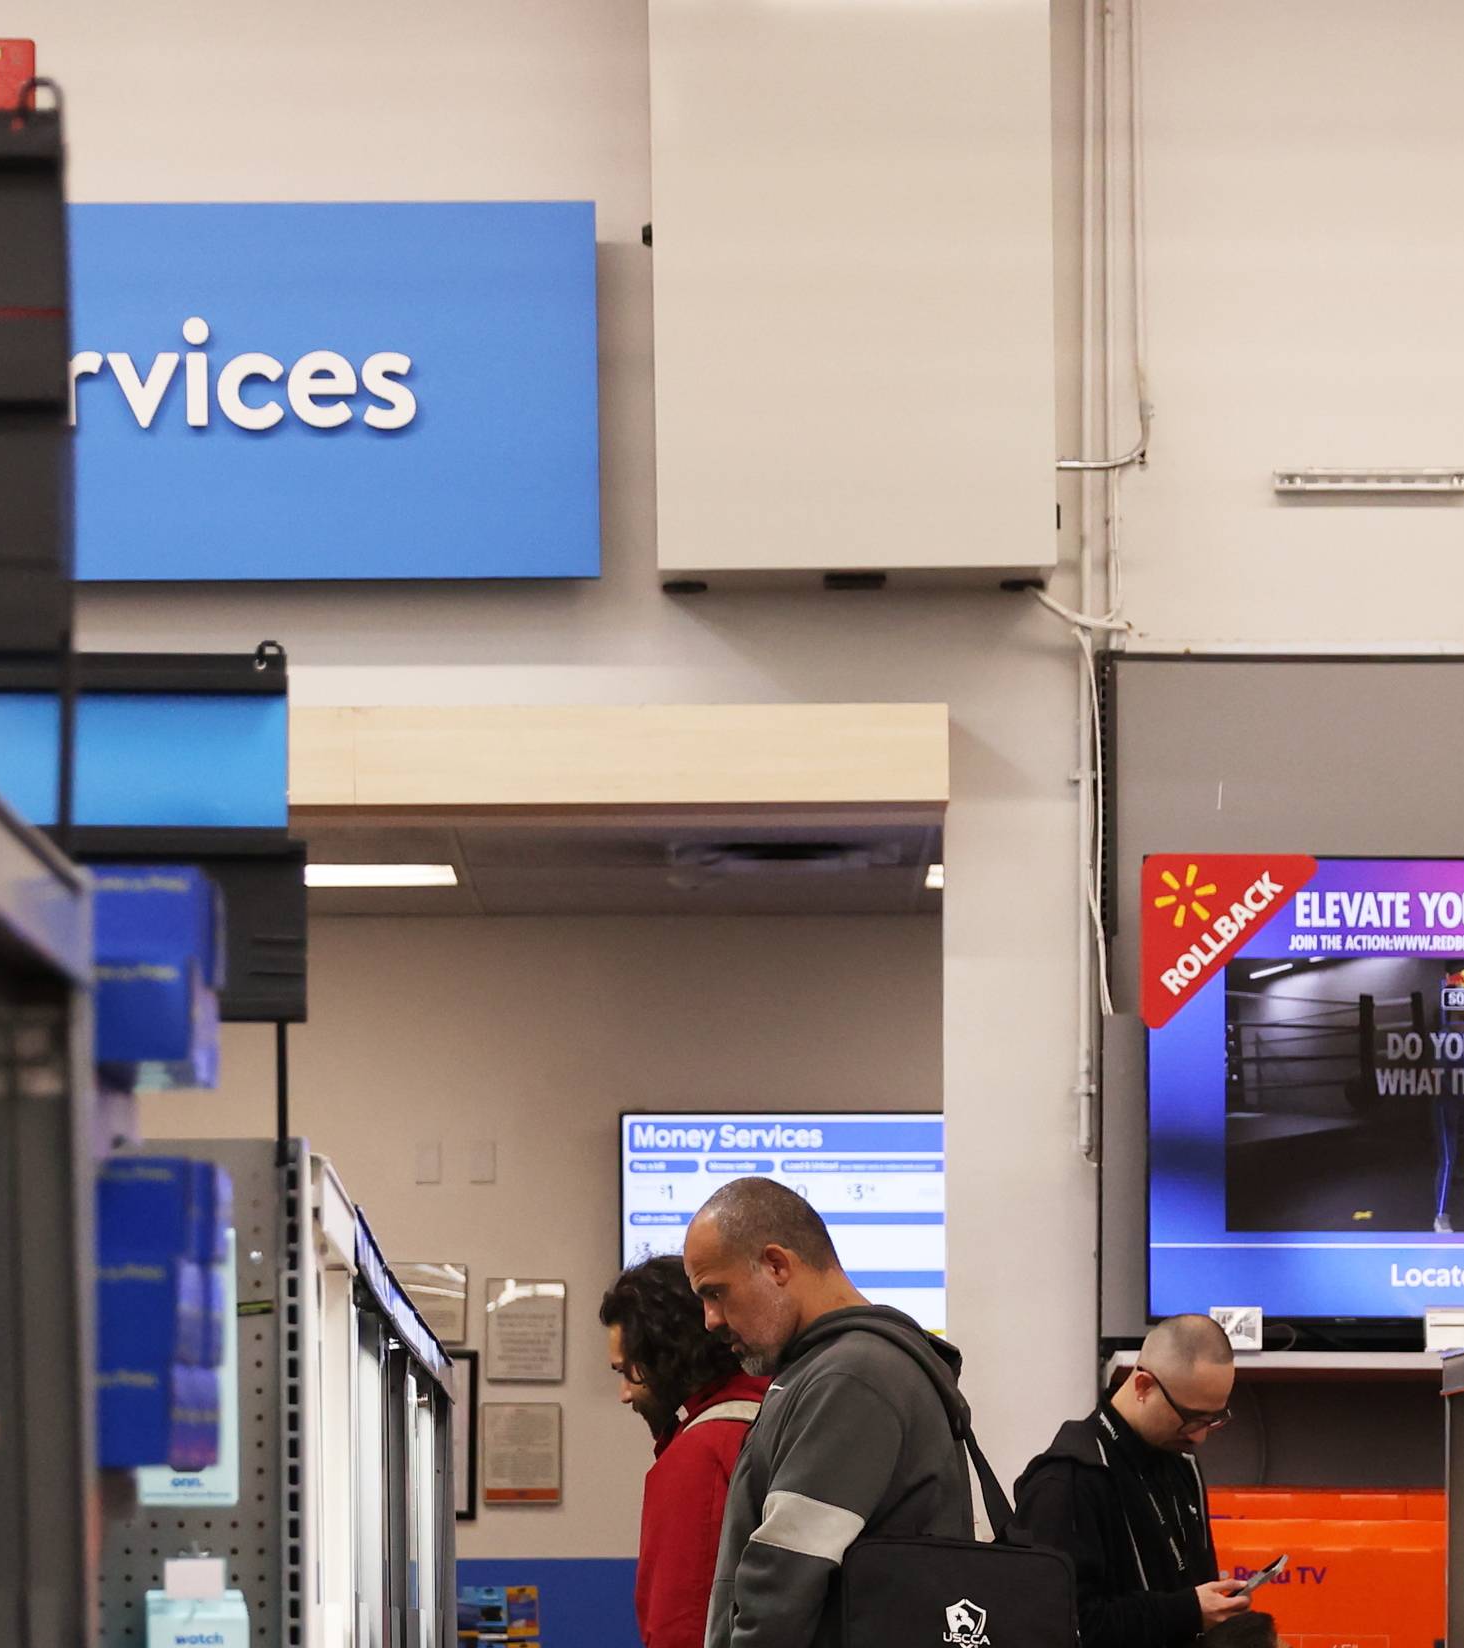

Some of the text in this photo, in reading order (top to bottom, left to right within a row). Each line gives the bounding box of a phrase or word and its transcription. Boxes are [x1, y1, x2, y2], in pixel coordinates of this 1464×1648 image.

[1294, 891, 1411, 929] ELEVATE
[1160, 871, 1285, 996] ROLLBACK
[1288, 934, 1321, 953] JOIN
[1321, 934, 1342, 953] THE
[1386, 1032, 1423, 1062] DO
[1375, 1067, 1445, 1097] WHAT
[634, 1123, 823, 1151] Money Services
[1296, 1566, 1327, 1585] TV
[942, 1631, 991, 1646] USCCA
